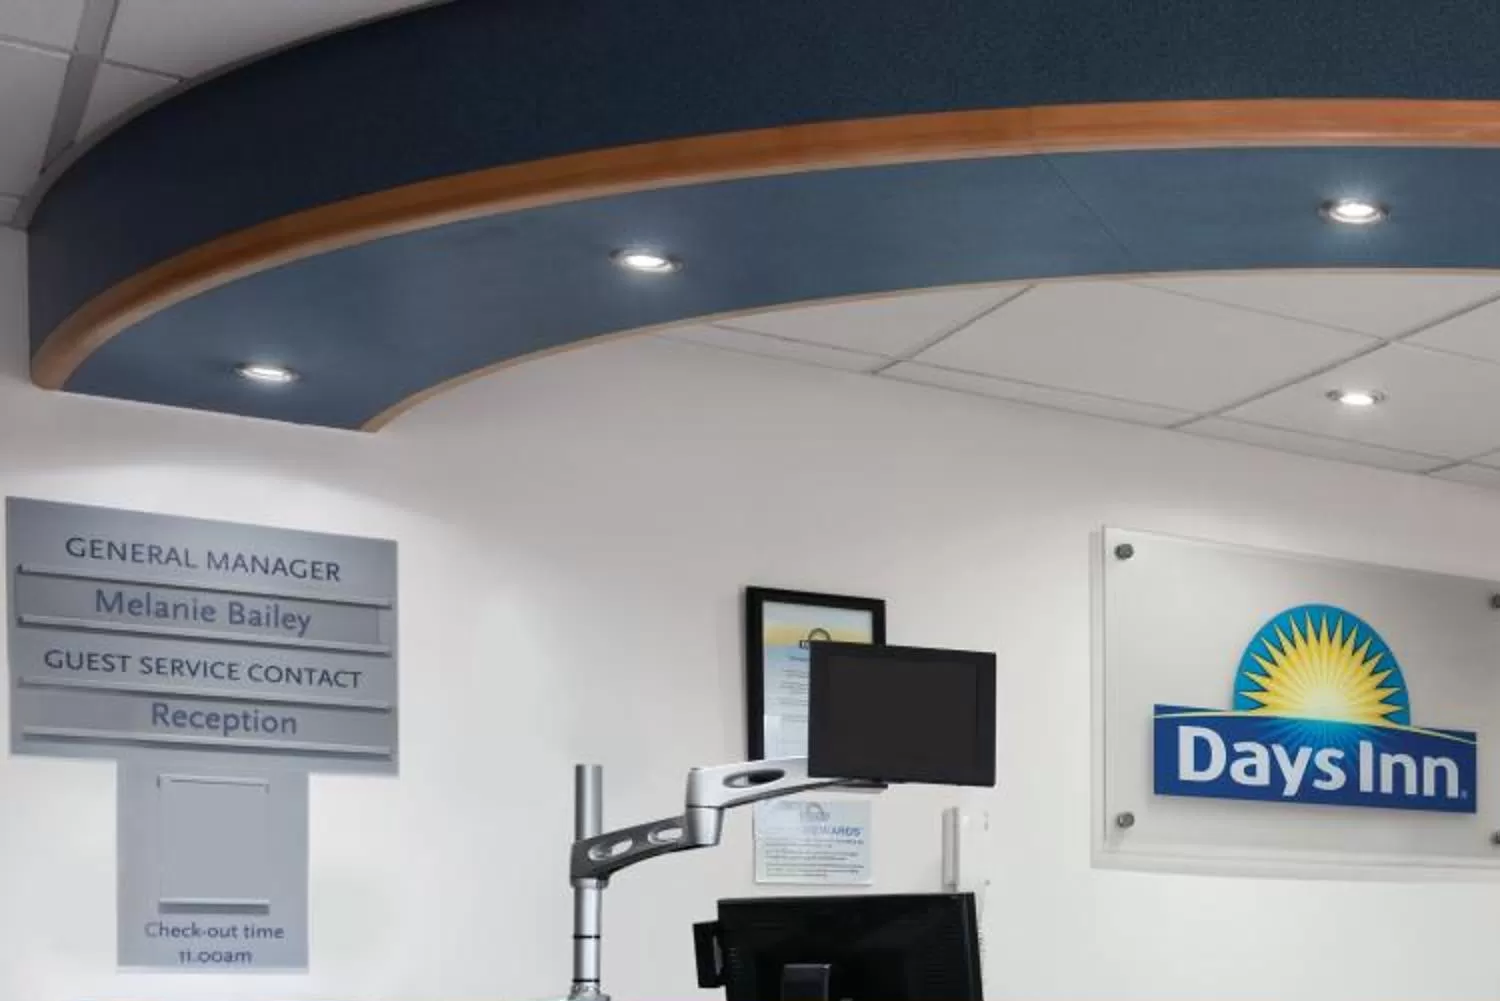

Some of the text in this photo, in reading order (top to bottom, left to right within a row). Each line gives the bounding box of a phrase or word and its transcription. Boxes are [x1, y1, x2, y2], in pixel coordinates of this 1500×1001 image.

[65, 536, 341, 583] GENERAL MANAGER
[95, 589, 312, 637] Melanie Bailey
[44, 648, 363, 689] GUEST SERVICE CONTACT
[151, 702, 297, 737] Reception
[1177, 725, 1460, 799] Days Inn
[144, 921, 285, 940] Check-out time
[178, 948, 252, 965] 11.00am
